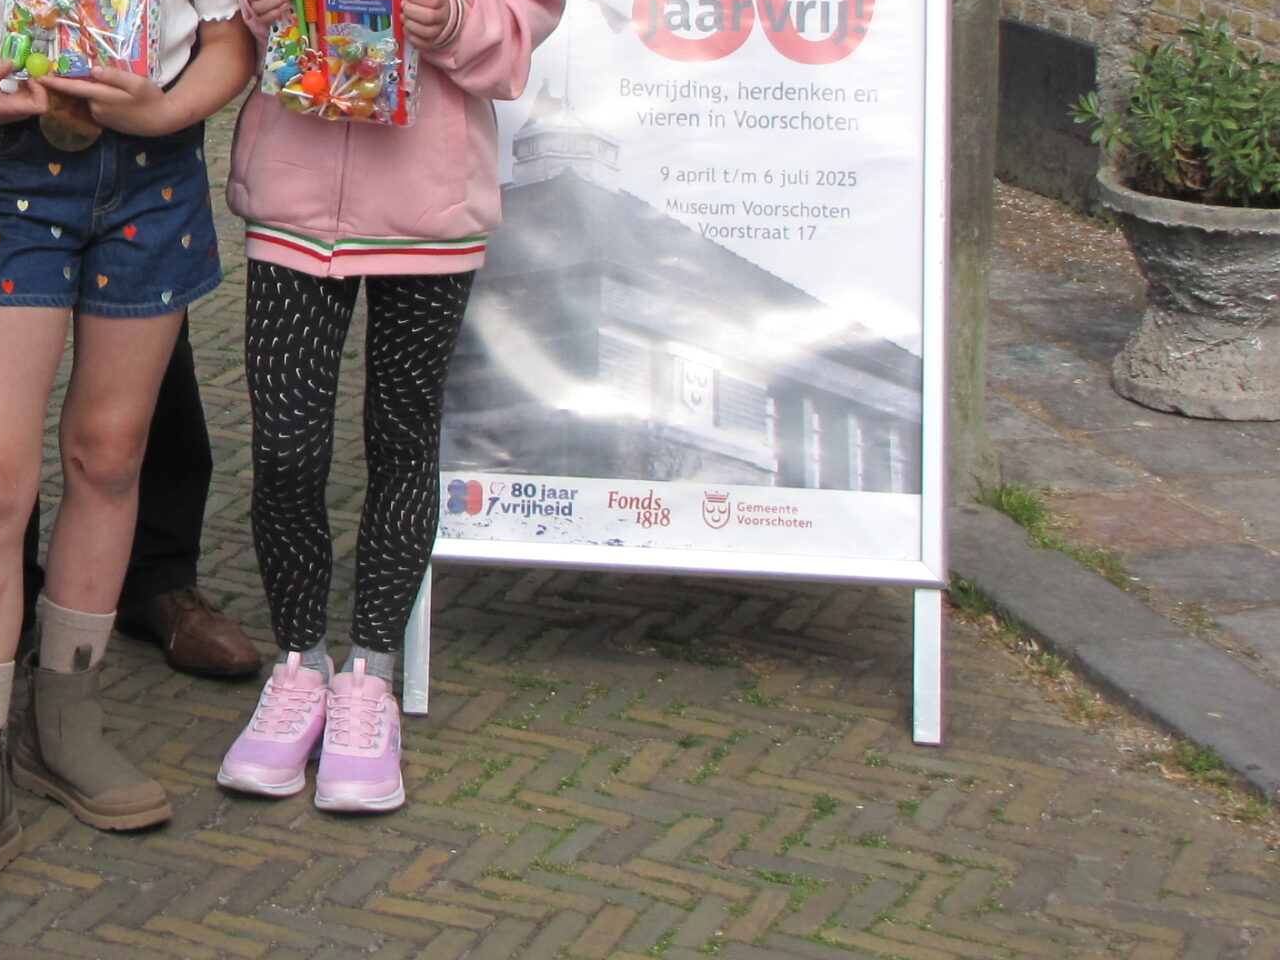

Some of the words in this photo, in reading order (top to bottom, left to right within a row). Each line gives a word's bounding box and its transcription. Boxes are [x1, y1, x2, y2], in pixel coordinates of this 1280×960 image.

[620, 78, 729, 103] Bevrijding,
[738, 81, 846, 102] herdenken
[854, 88, 879, 103] en
[637, 108, 700, 128] vieren
[708, 110, 726, 128] in
[733, 110, 860, 132] Voorschoten
[660, 166, 670, 181] 9
[676, 168, 716, 185] april
[723, 168, 757, 184] t/m
[763, 169, 774, 185] 6
[779, 169, 809, 188] juli
[816, 171, 858, 187] 2025
[666, 199, 735, 216] Museum
[742, 200, 851, 219] Voorschoten
[698, 222, 790, 240] Voorstraat
[798, 225, 817, 241] 17
[510, 482, 537, 499] 80
[540, 484, 579, 502] jaar
[607, 489, 663, 511] Fonds
[500, 500, 573, 518] vrijheid
[736, 501, 799, 515] Gemeente
[635, 507, 671, 530] 1818
[736, 514, 813, 529] Voorschoten
